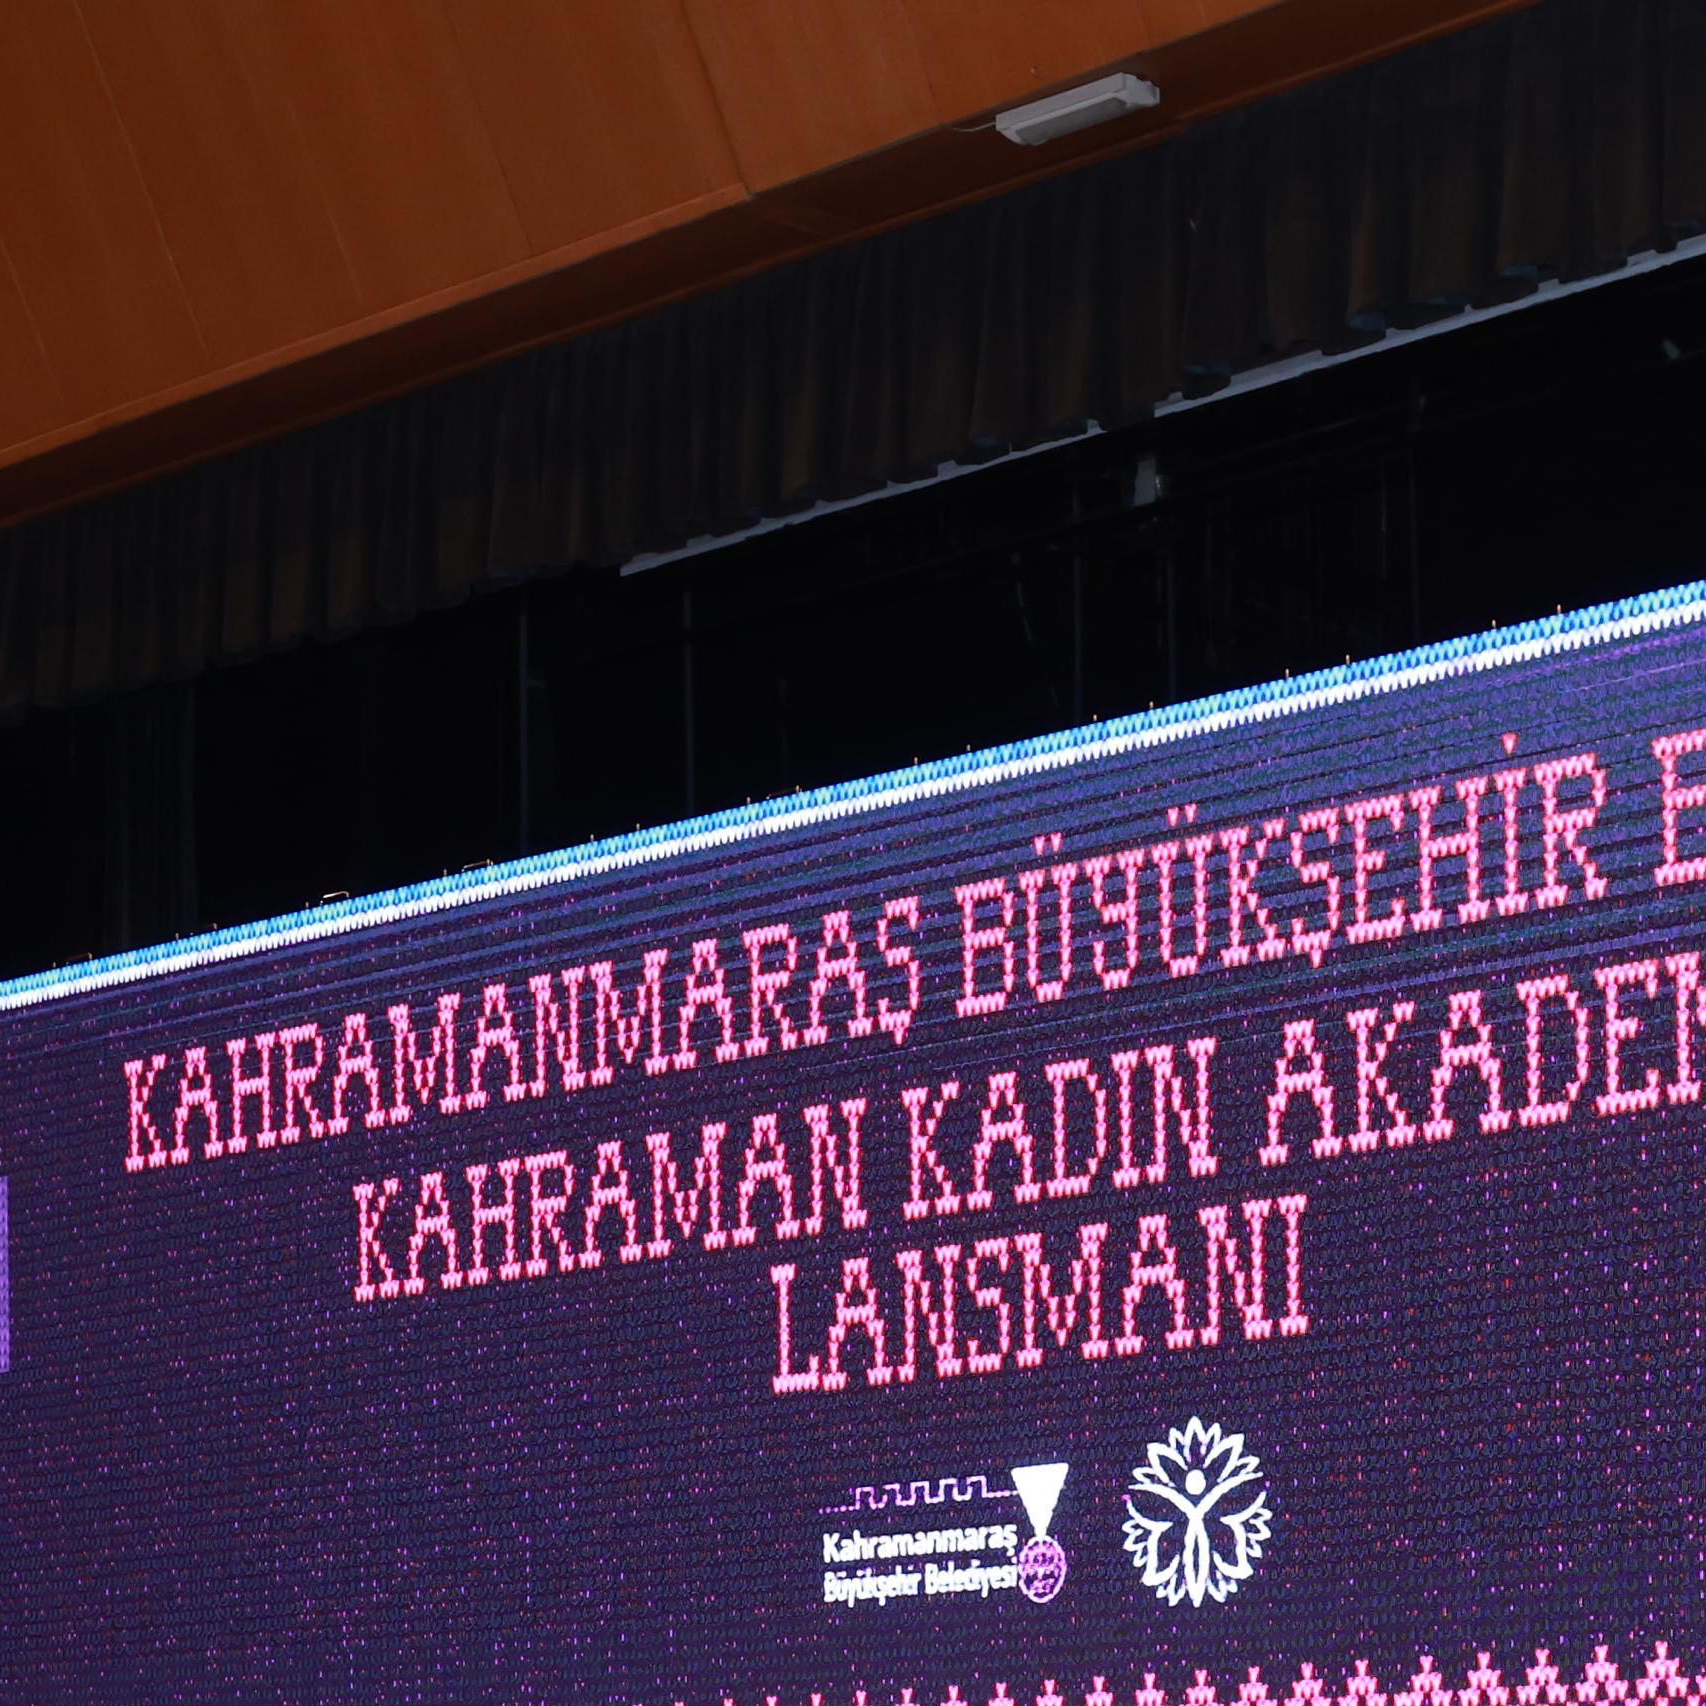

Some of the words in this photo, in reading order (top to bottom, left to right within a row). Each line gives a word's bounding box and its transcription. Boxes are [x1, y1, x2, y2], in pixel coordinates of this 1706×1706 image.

[124, 896, 923, 1174] KAHRAMANMARAŞ
[954, 733, 1607, 1017] BÜYÜKŞEHİR
[353, 1099, 868, 1302] KAHRAMAN
[902, 1037, 1217, 1220] KADIN
[770, 1195, 1309, 1394] LANSMANI
[823, 1524, 1018, 1563] Kahramanmaraş
[823, 1565, 922, 1608] Büyükşehir
[925, 1557, 1018, 1598] Belediyesi
